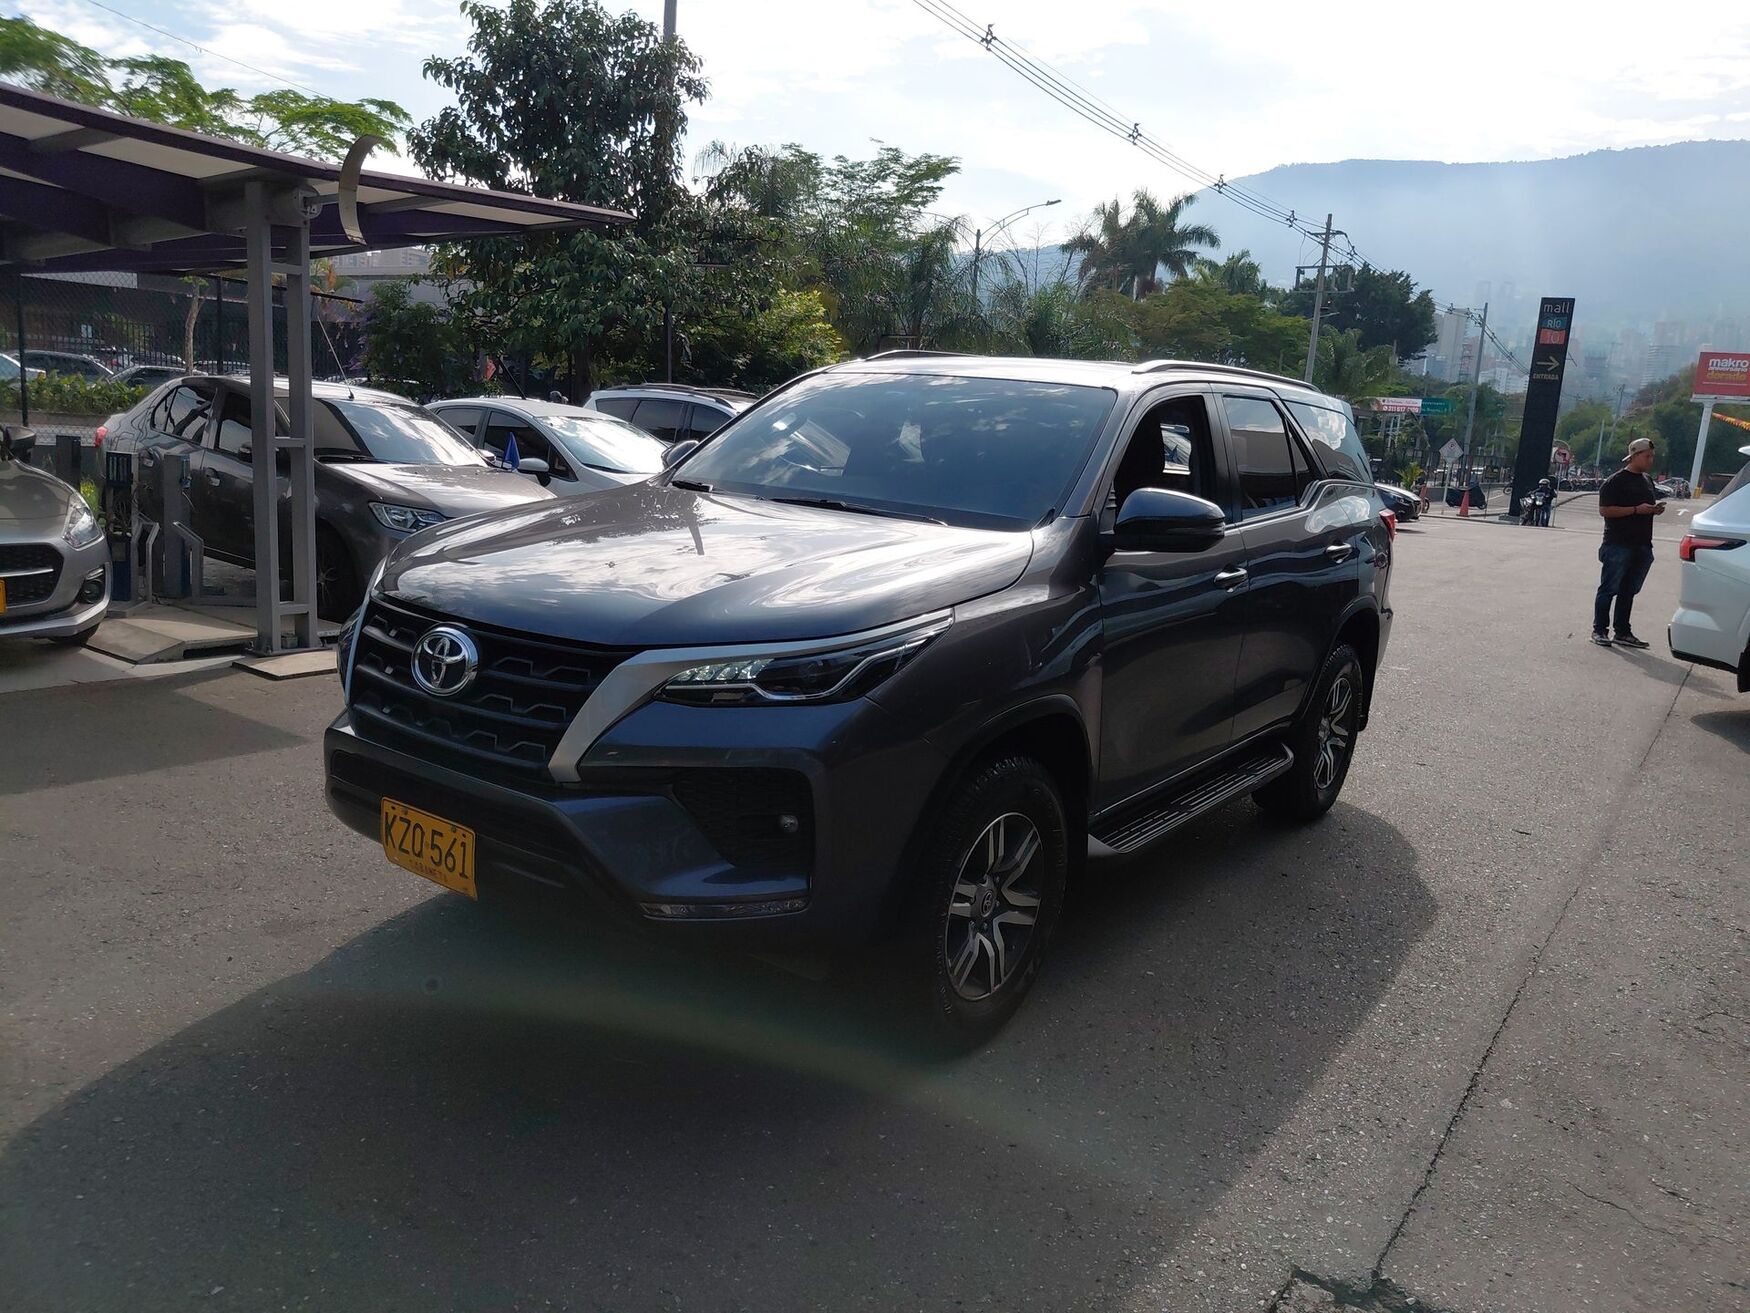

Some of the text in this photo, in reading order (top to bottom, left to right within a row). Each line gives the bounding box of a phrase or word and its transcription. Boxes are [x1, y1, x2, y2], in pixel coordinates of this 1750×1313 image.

[1543, 301, 1570, 313] mall
[1709, 358, 1749, 367] makro
[1707, 371, 1747, 380] dorado
[430, 829, 468, 879] 561
